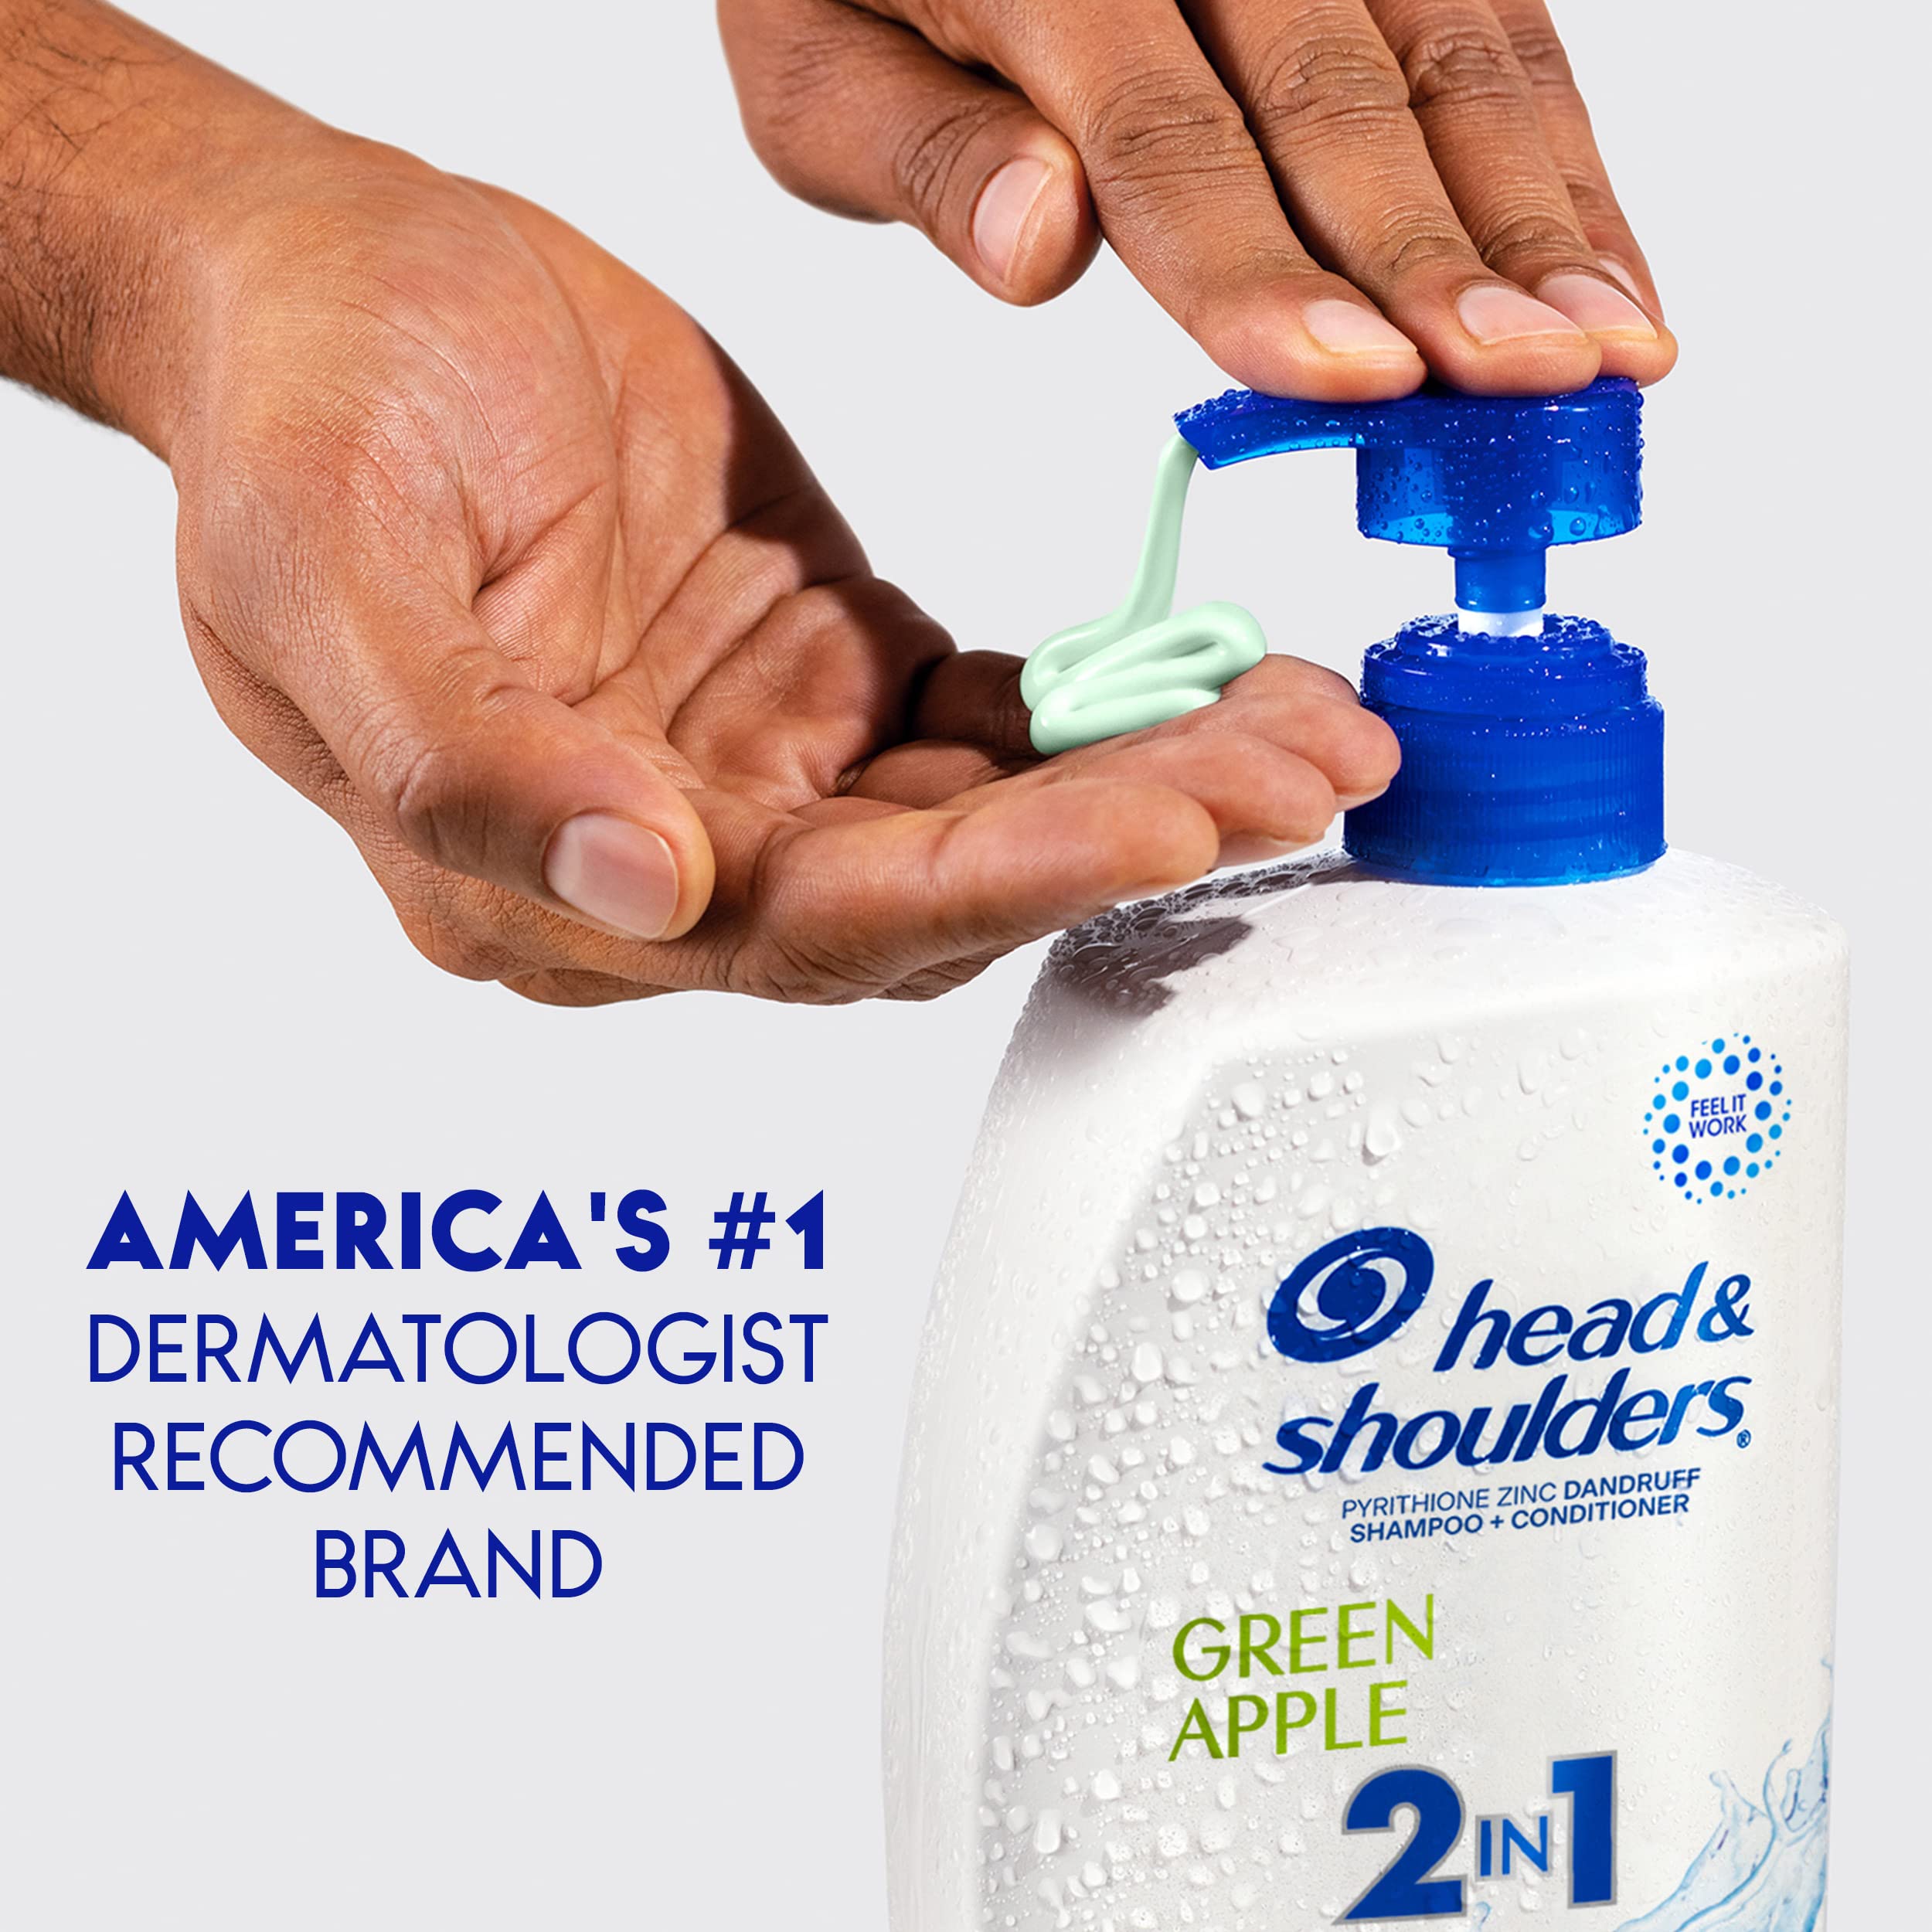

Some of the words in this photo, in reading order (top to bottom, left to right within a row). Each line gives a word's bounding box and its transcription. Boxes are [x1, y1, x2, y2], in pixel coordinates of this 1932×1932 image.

[1689, 1114, 1747, 1139] WORK
[1690, 1096, 1730, 1118] FEEL
[1732, 1094, 1747, 1112] IT
[1433, 1260, 1709, 1373] head
[1695, 1273, 1755, 1344] &
[1342, 1488, 1490, 1519] PYRITHIONE
[1497, 1481, 1557, 1506] ZINC
[1563, 1467, 1702, 1501] DANDRUFF
[1349, 1513, 1484, 1544] SHAMPOO
[1490, 1515, 1505, 1529] +
[1510, 1493, 1691, 1530] CONDITIONER
[1172, 1593, 1435, 1682] GREEN
[1167, 1679, 1409, 1763] APPLE
